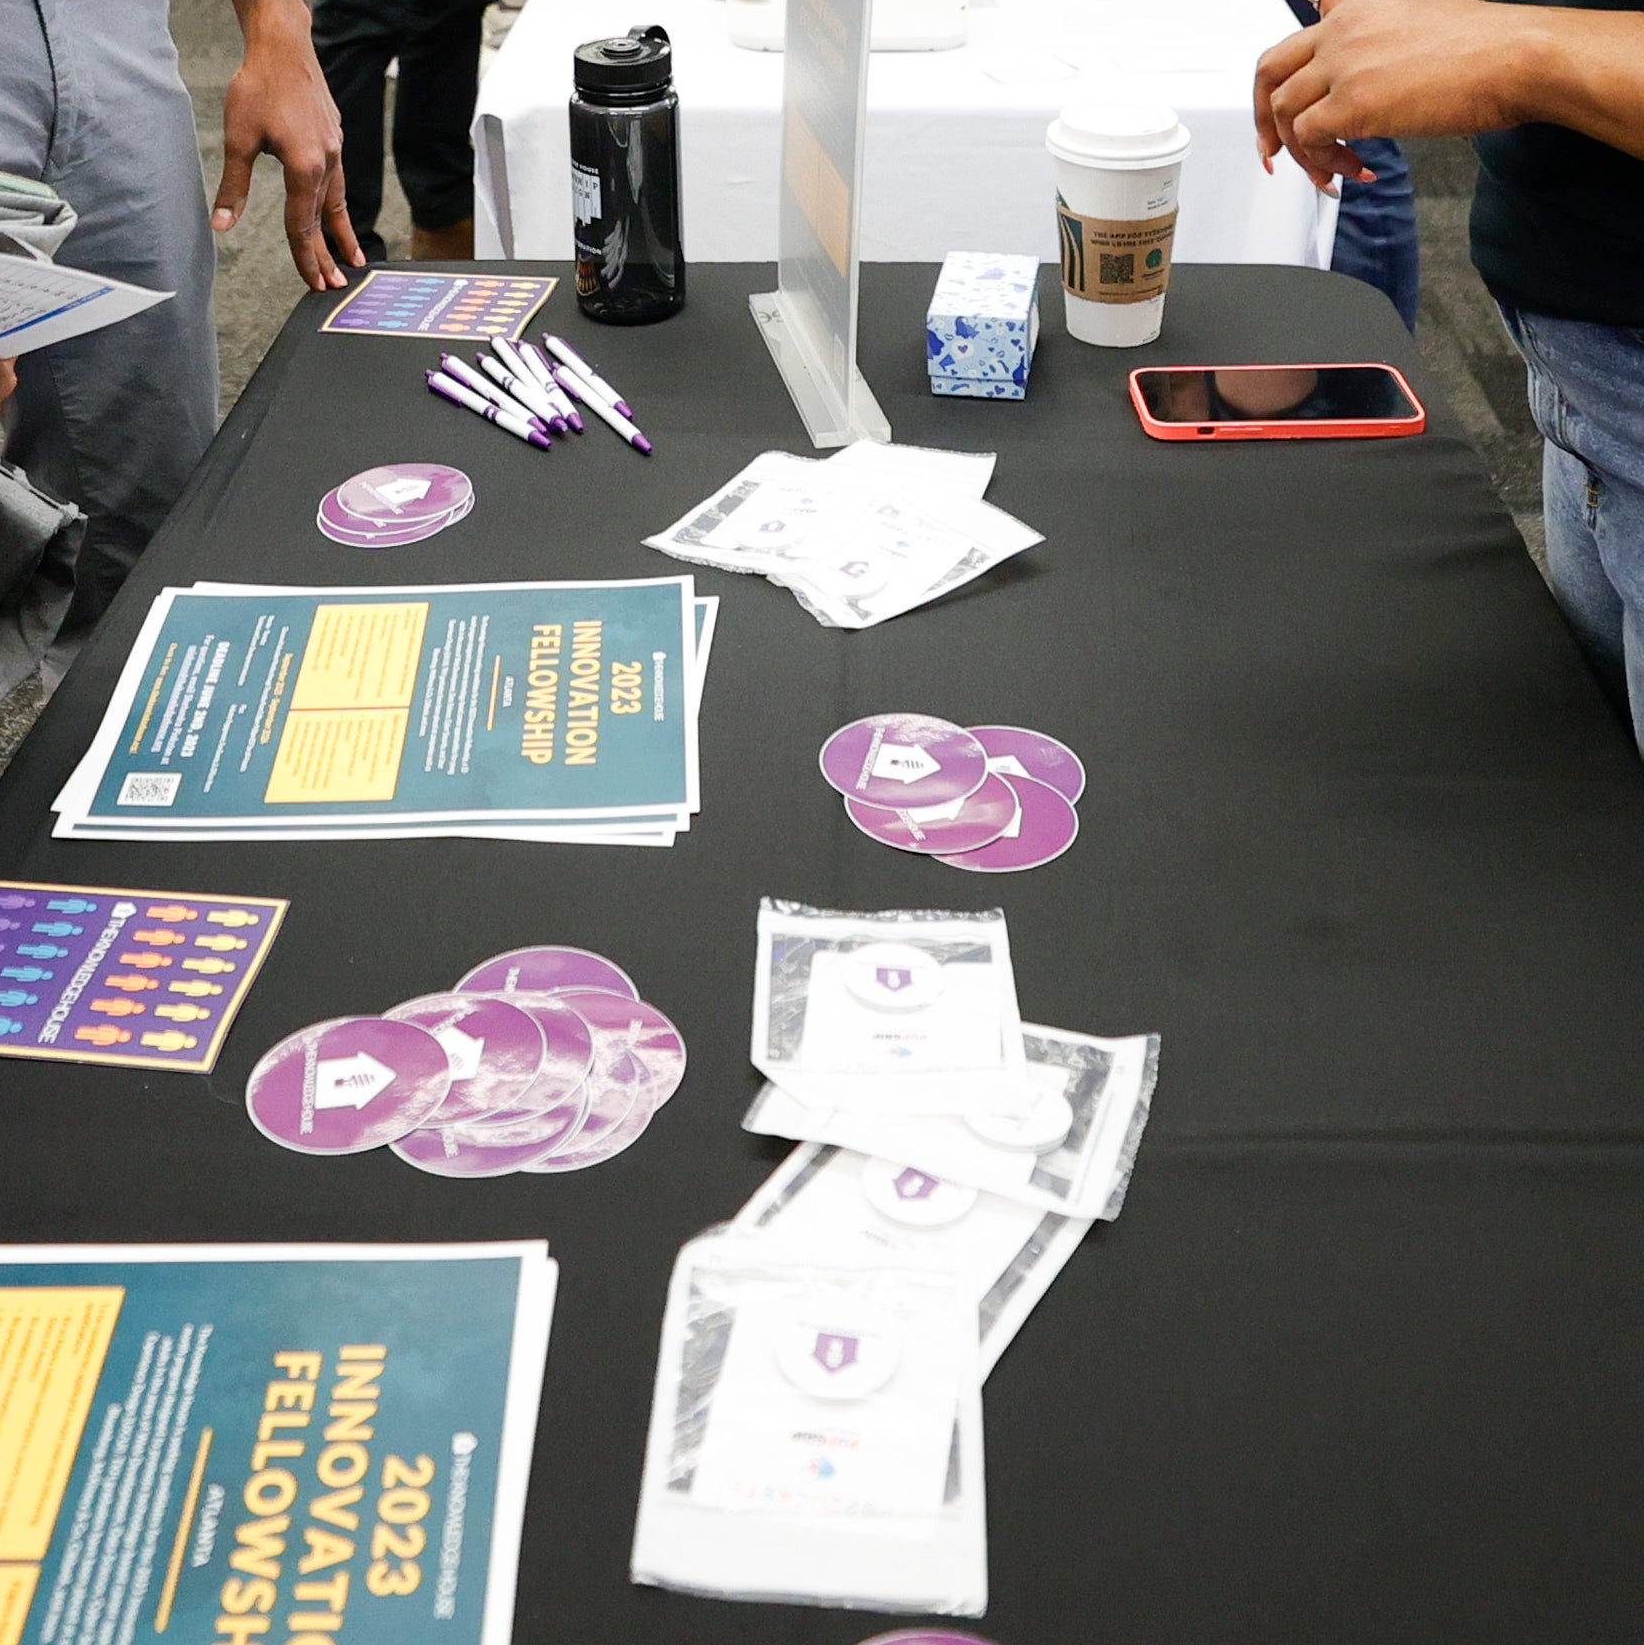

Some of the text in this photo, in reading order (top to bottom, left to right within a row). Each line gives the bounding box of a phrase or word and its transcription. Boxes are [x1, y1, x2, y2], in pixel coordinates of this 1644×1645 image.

[194, 684, 216, 708] JUNE
[203, 641, 230, 683] DEADLINE
[517, 623, 564, 765] FELLOWSHIP
[561, 619, 604, 765] INNOVATION
[608, 660, 644, 714] 2023
[177, 733, 199, 757] 2023
[188, 1483, 228, 1567] ATLANTA
[282, 1343, 389, 1645] INNOVATI
[362, 1453, 438, 1597] 2023
